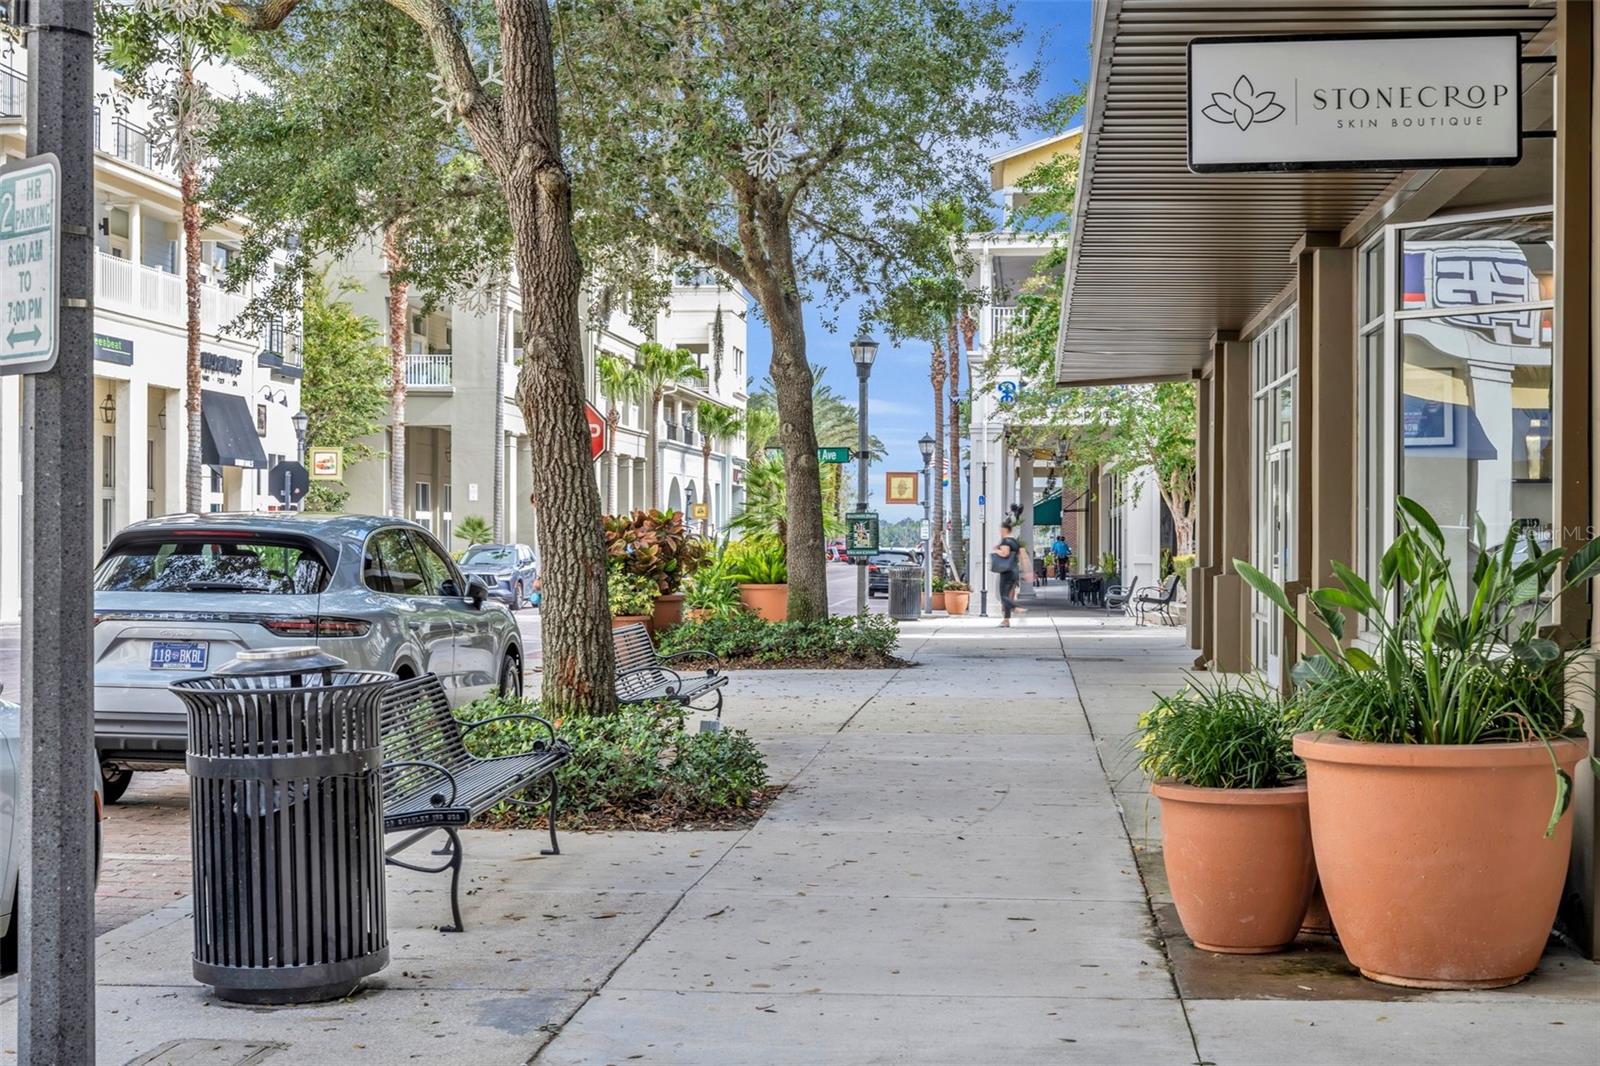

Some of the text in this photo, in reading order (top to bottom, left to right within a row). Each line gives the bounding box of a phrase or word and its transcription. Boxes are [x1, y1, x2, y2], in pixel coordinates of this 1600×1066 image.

[1312, 84, 1509, 111] STONECROP
[1336, 116, 1483, 129] SKIN BOUTIQUE
[27, 178, 43, 200] HR
[0, 192, 14, 233] 2
[15, 203, 51, 232] PARKING
[8, 239, 43, 268] 8:00 AM
[18, 270, 32, 293] TO
[7, 296, 43, 324] 7:00 PM
[822, 449, 836, 460] Ave
[153, 648, 171, 663] 118
